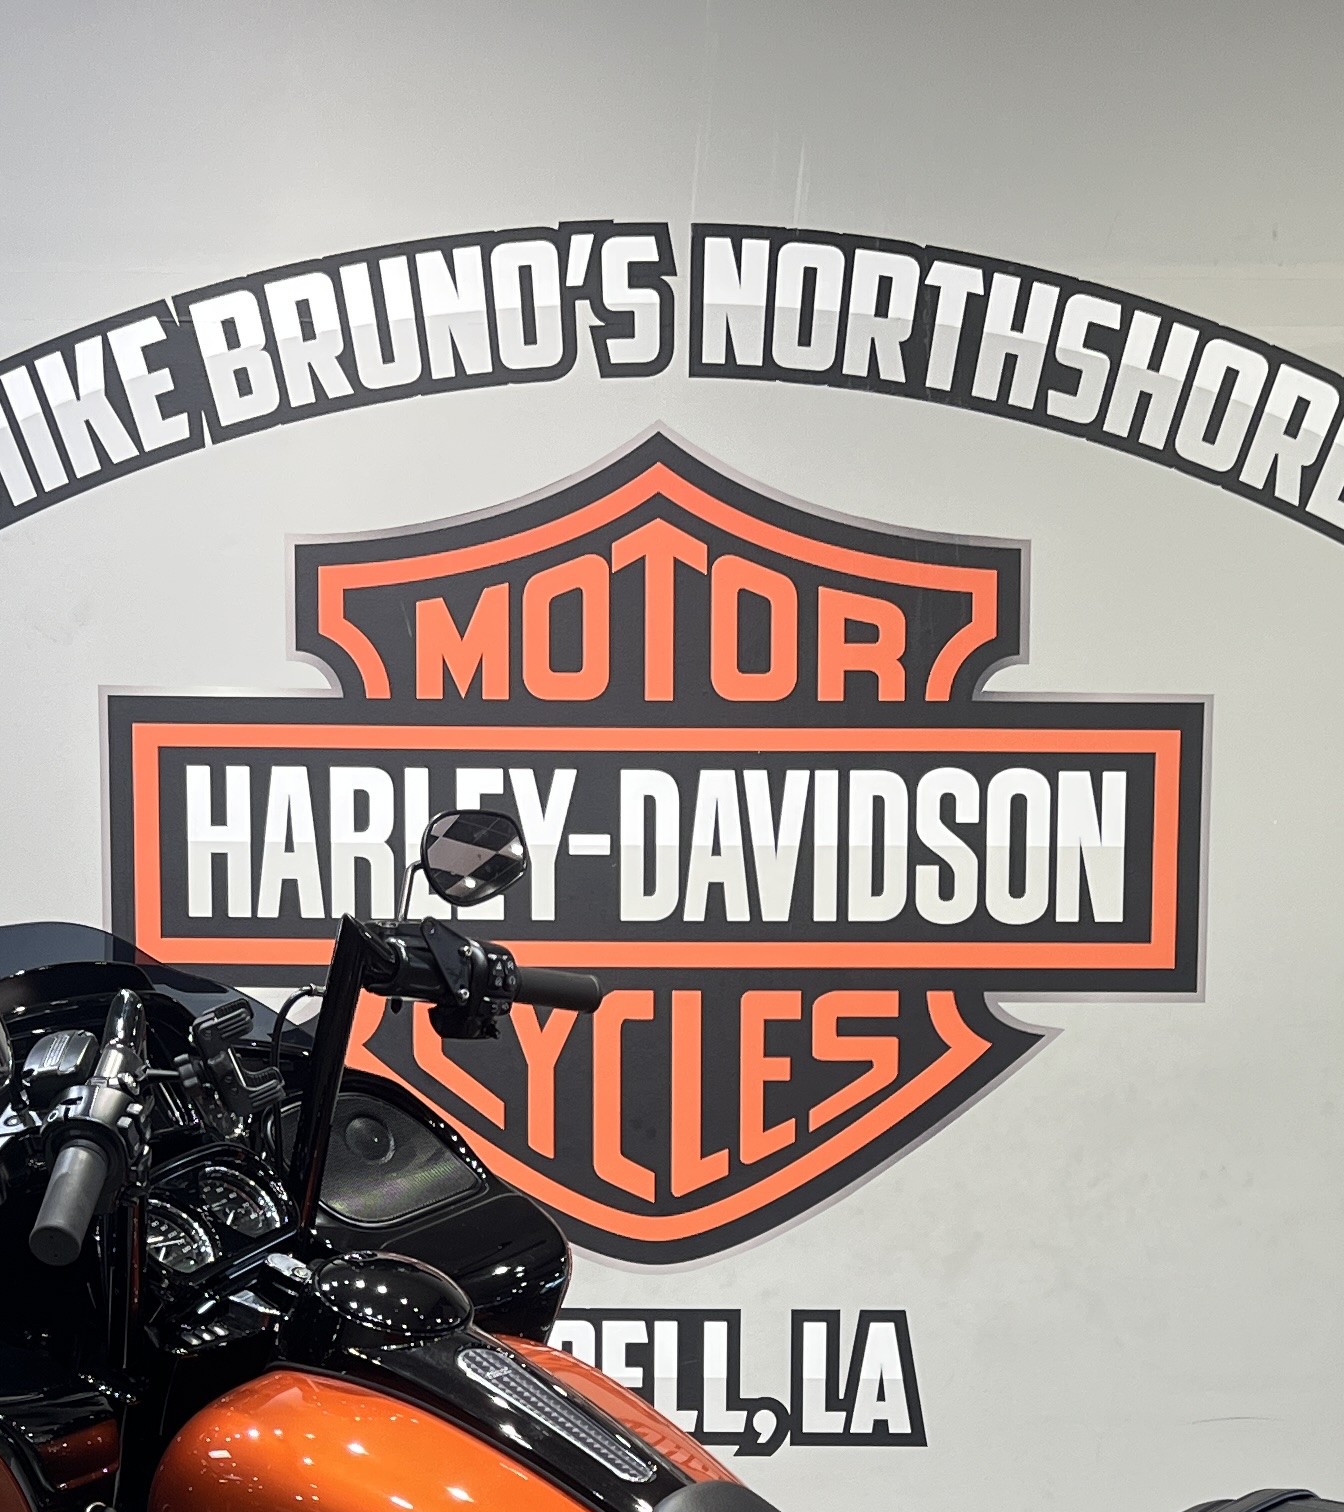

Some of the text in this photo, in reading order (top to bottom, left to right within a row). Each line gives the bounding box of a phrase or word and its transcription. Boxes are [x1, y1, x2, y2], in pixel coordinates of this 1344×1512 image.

[188, 234, 662, 427] BRUNO'S
[415, 517, 906, 702] MOTOR
[184, 763, 1127, 925] HARLEY-DAVIDSON
[413, 989, 900, 1203] CYCLES
